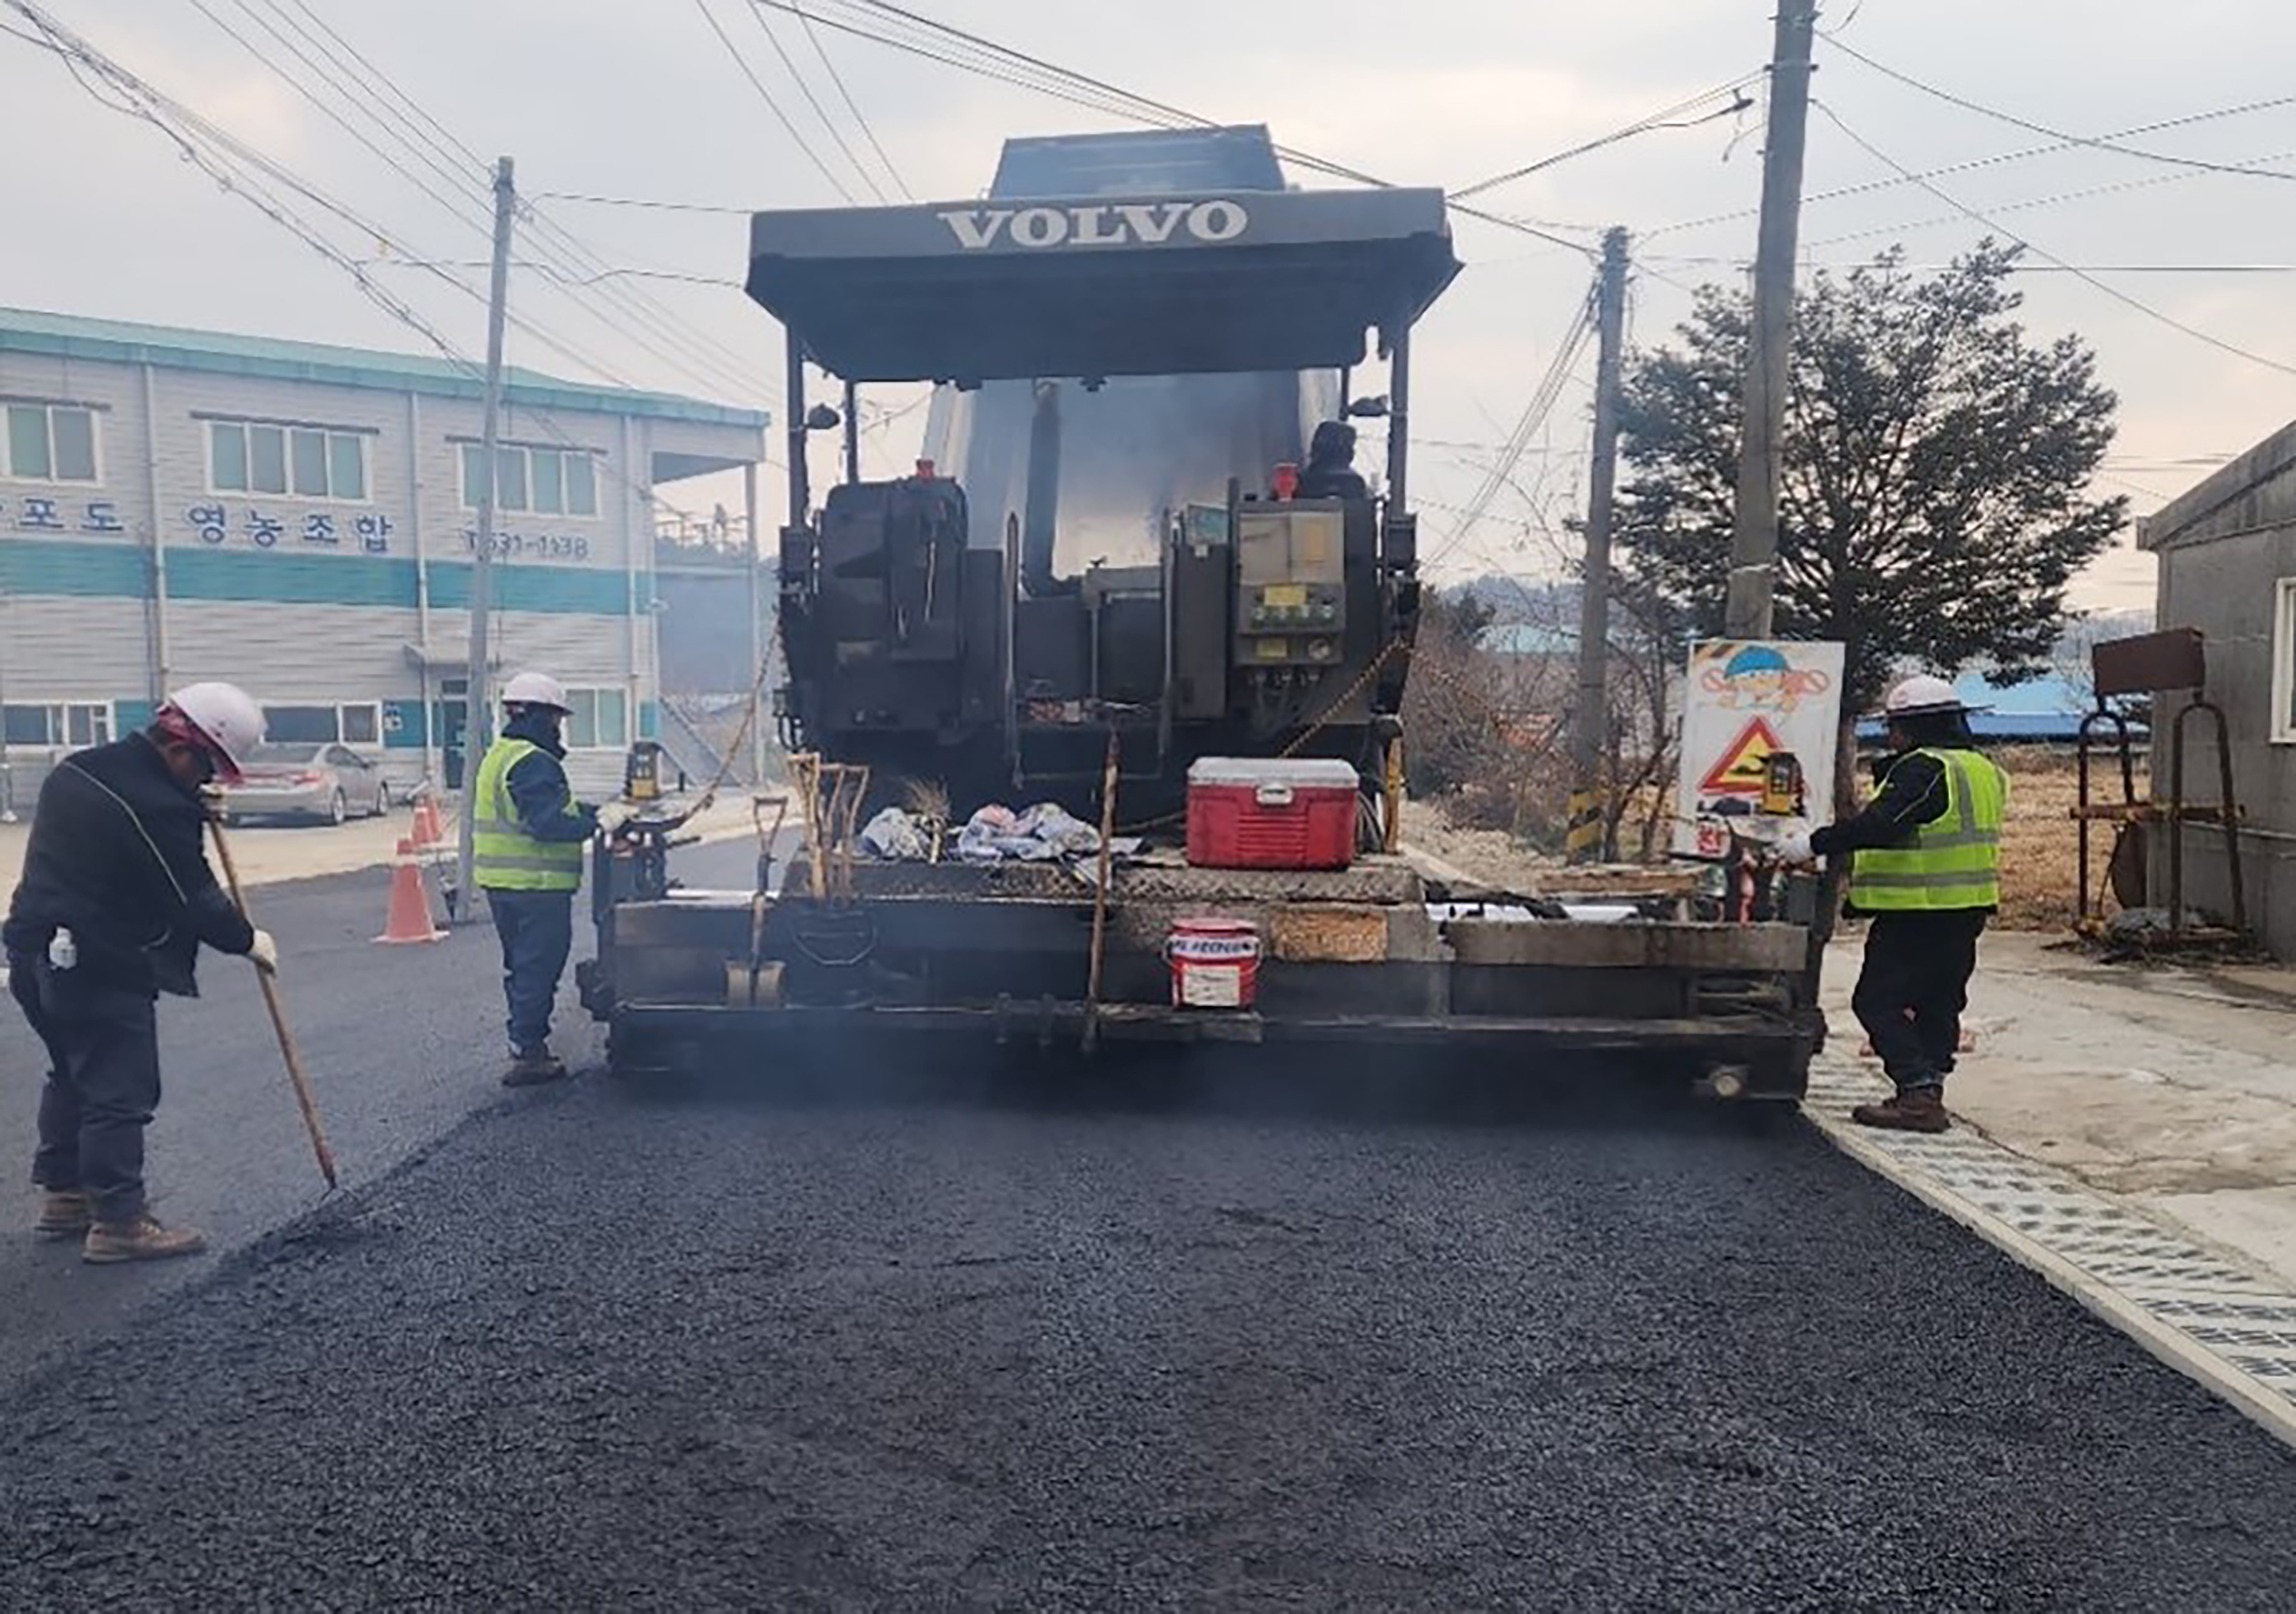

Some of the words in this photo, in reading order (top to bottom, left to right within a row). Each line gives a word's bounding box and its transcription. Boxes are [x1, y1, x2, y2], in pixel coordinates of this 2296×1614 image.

[936, 199, 1248, 248] VOLVO
[0, 498, 124, 531] 포도
[188, 504, 392, 552] 영농조합
